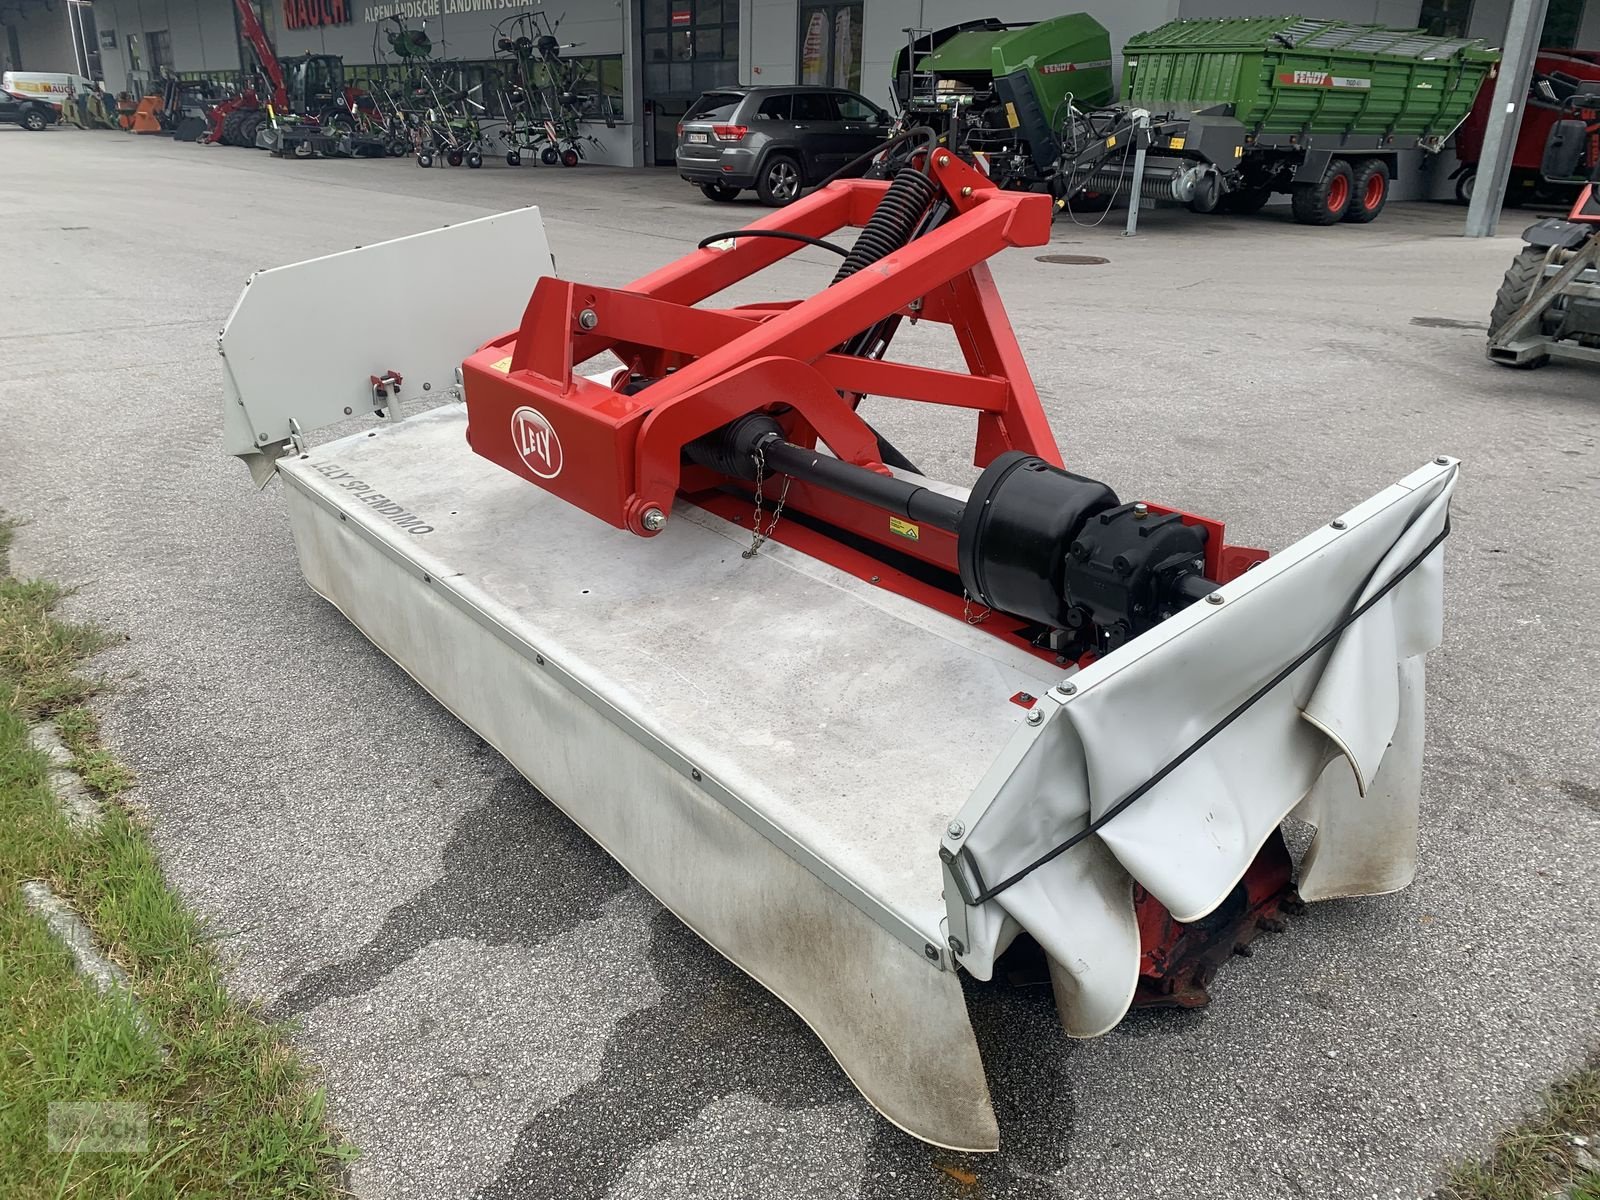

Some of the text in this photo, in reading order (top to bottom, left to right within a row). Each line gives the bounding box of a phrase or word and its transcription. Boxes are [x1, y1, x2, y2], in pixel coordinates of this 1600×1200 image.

[444, 0, 541, 14] LANDWIRTSC
[283, 0, 346, 31] MAUCH
[1044, 62, 1071, 74] FENDT
[1294, 70, 1328, 84] FENDT
[43, 84, 76, 94] MAUCH
[518, 414, 552, 469] LELY
[310, 460, 434, 535] LELY SPLENDIMO
